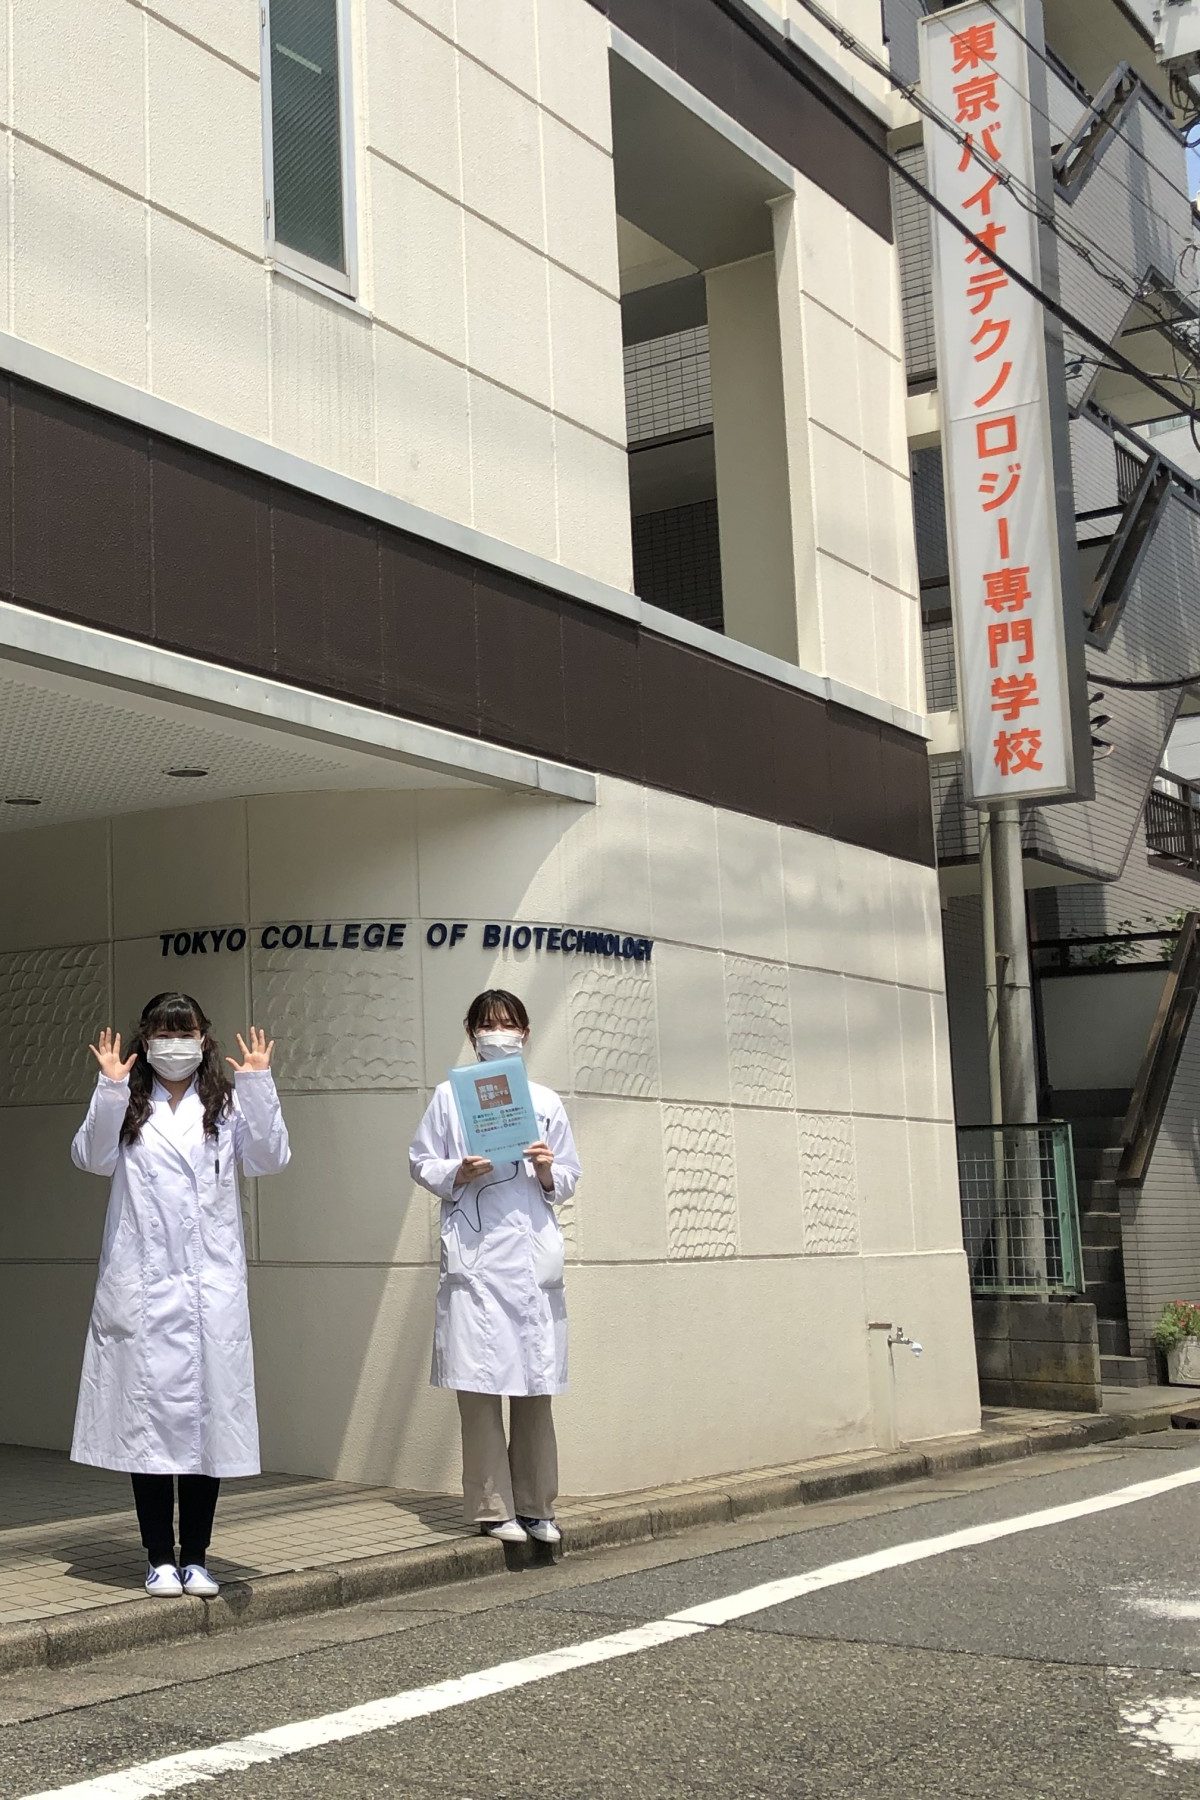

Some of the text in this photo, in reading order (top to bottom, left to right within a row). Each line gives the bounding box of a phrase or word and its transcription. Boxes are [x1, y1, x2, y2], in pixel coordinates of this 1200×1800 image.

[950, 21, 1043, 776] 東京バイオテクノロジー専門学校
[159, 922, 654, 961] TOKYO COLLEGE OF BIOTECHNOLOGY
